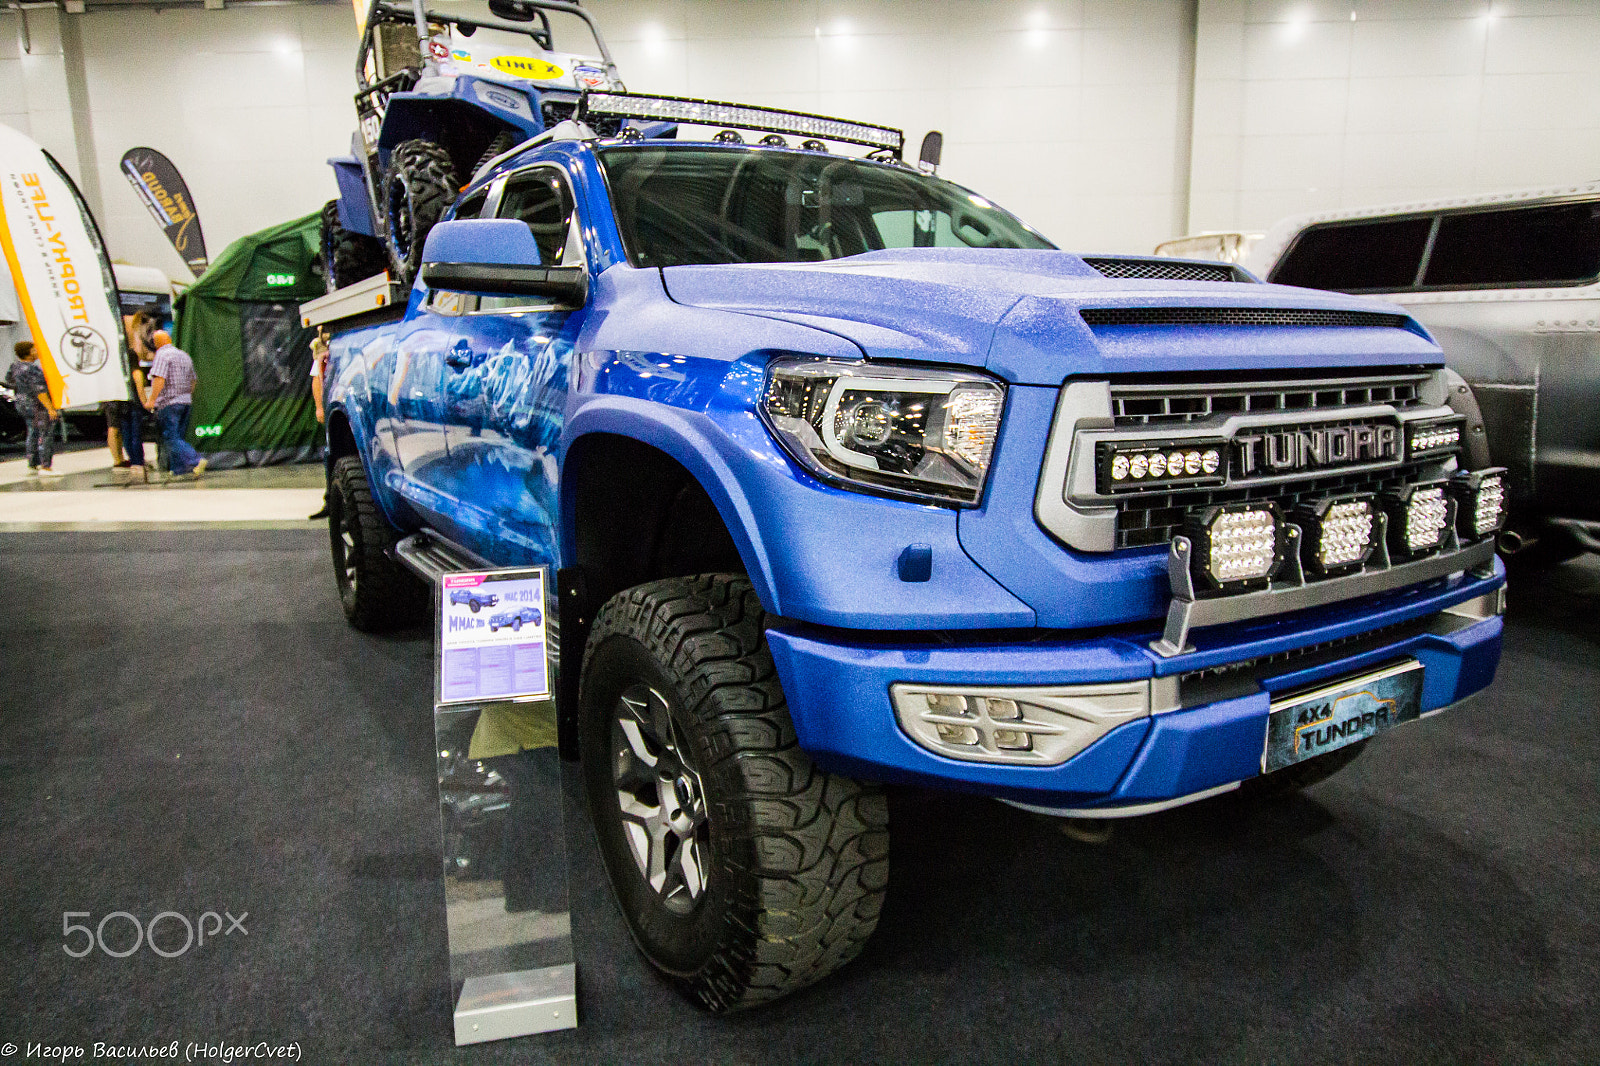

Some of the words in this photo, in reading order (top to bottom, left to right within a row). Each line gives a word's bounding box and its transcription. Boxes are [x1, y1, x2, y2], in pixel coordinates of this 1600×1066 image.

[496, 58, 536, 71] LINE
[1235, 424, 1396, 477] TUNDRA
[520, 588, 541, 602] 2014
[449, 615, 475, 633] MMAC
[1302, 707, 1388, 750] TUNDRA
